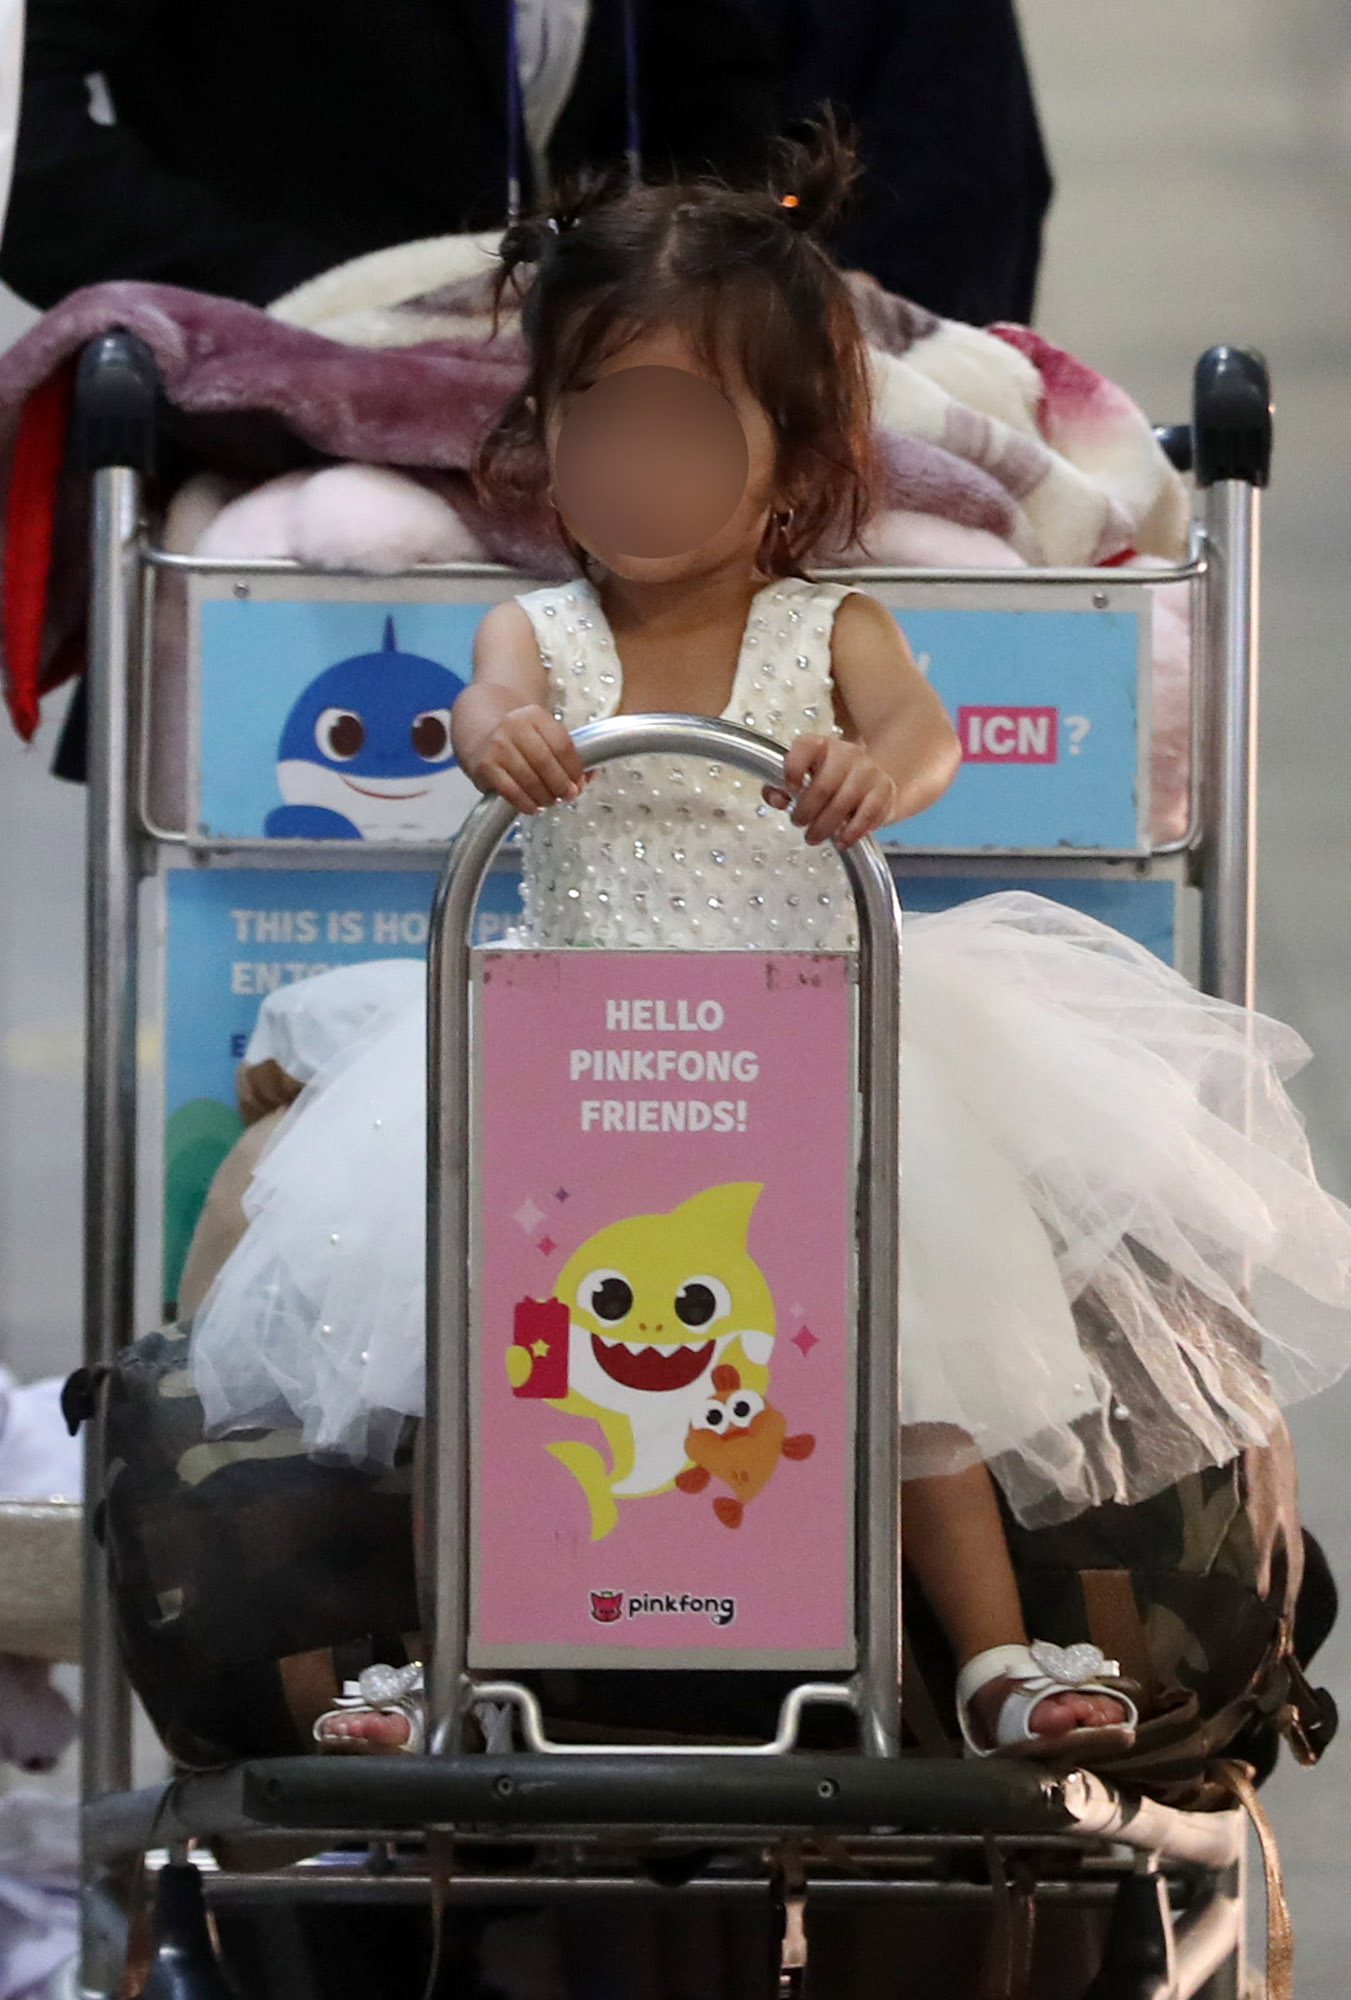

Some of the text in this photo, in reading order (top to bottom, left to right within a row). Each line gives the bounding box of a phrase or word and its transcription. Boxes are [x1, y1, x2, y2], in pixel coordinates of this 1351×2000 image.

[967, 715, 1050, 756] ICN
[231, 909, 429, 945] THIS IS HO
[606, 1000, 724, 1032] HELLO
[569, 1049, 760, 1082] PINKFONG
[581, 1100, 748, 1132] FRIENDS!
[628, 1592, 736, 1627] pinkfong
